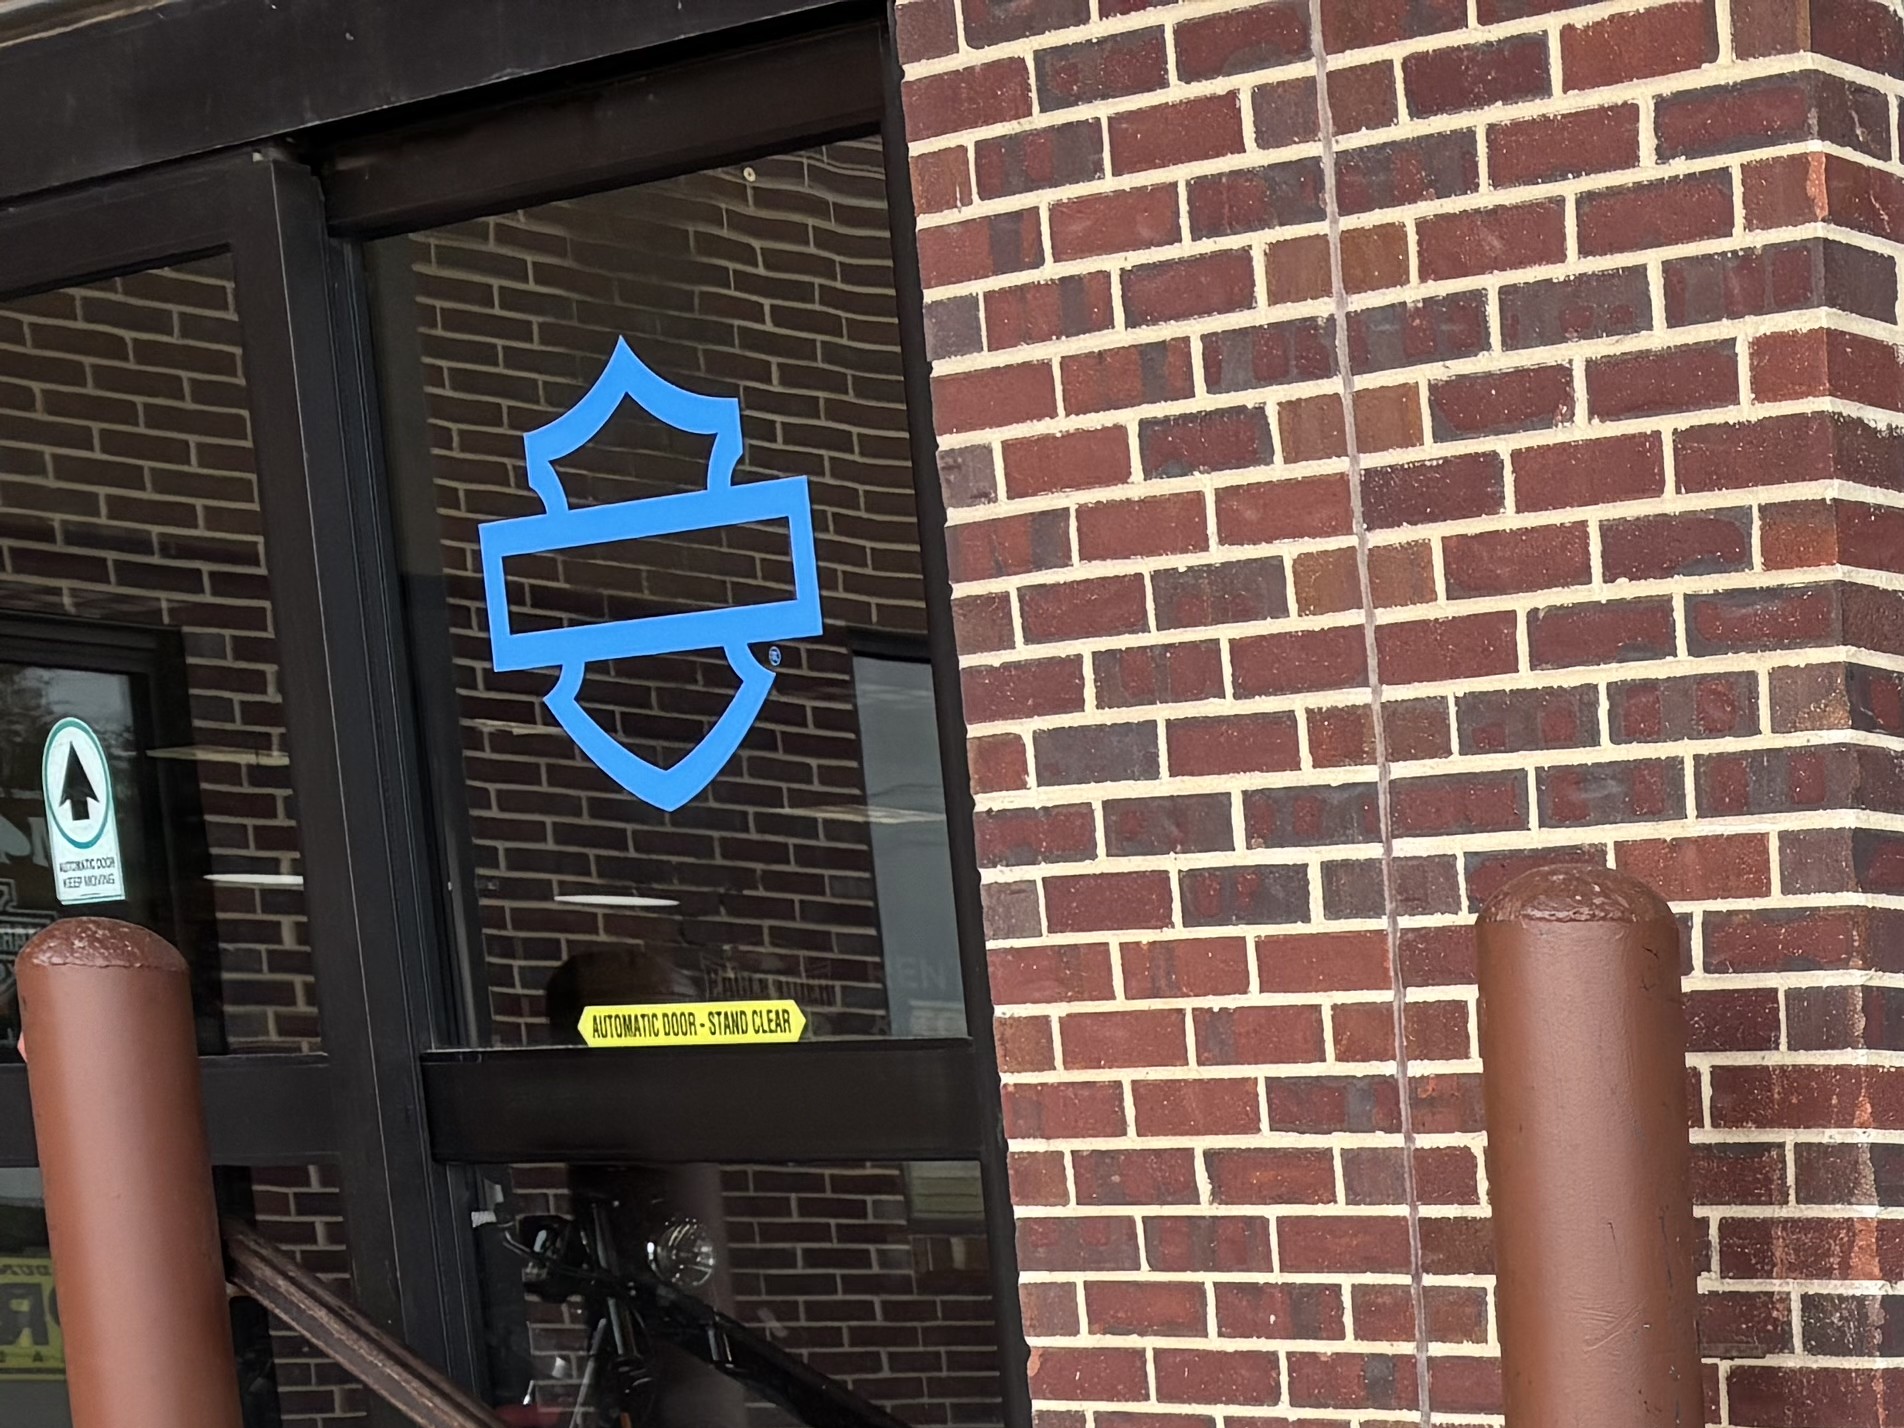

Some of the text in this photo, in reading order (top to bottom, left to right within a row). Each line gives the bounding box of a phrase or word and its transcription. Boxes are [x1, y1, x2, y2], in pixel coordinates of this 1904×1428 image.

[63, 876, 82, 889] KEEP
[592, 1012, 660, 1039] AUTOMATIC
[662, 1011, 698, 1037] DOOR
[707, 1009, 749, 1036] STAND
[751, 1008, 792, 1034] CLEAR
